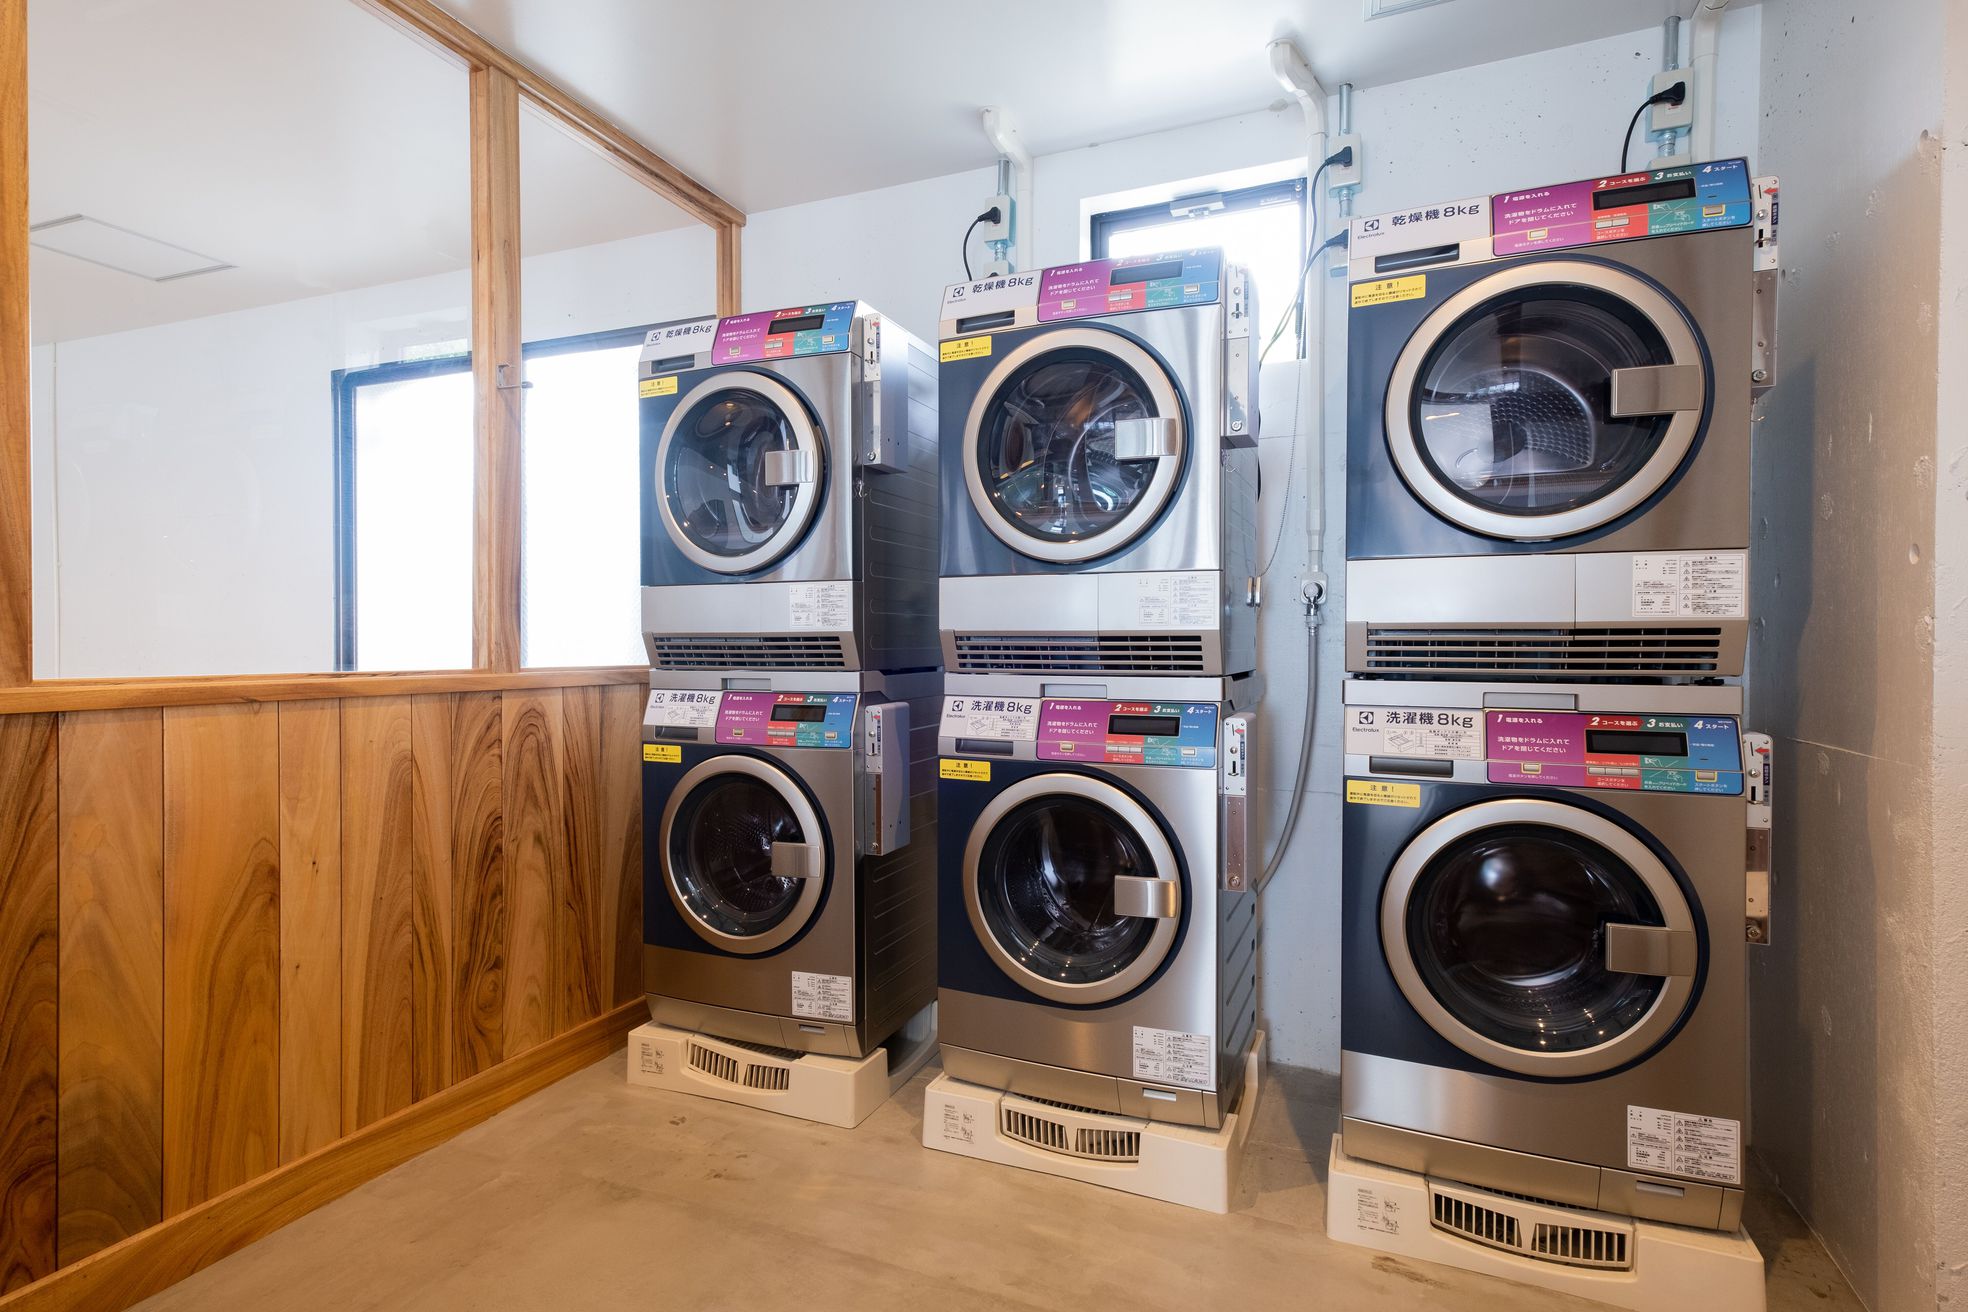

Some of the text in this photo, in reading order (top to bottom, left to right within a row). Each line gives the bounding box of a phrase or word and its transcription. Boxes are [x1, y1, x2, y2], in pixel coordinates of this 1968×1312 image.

[1702, 165, 1712, 174] 4
[1654, 171, 1664, 180] 3
[1598, 180, 1607, 188] 2
[1504, 195, 1510, 203] 1
[1391, 204, 1480, 227] 乾燥機8kg
[1504, 203, 1577, 219] 洗濯物をドラムに入れて
[1357, 231, 1385, 240] Electrolux
[973, 277, 1033, 293] 乾燥機8kg
[670, 693, 716, 704] 洗濯機8kg
[971, 700, 1032, 714] 洗濯機8kg
[1386, 711, 1473, 728] 洗濯機8kg
[1497, 714, 1503, 722] 1
[1590, 717, 1600, 725] 2
[1647, 719, 1656, 727] 3
[1694, 720, 1703, 729] 4
[1497, 736, 1570, 745] 洗濯物をドラムに入れて
[1502, 745, 1566, 753] ドアを閉じてください
